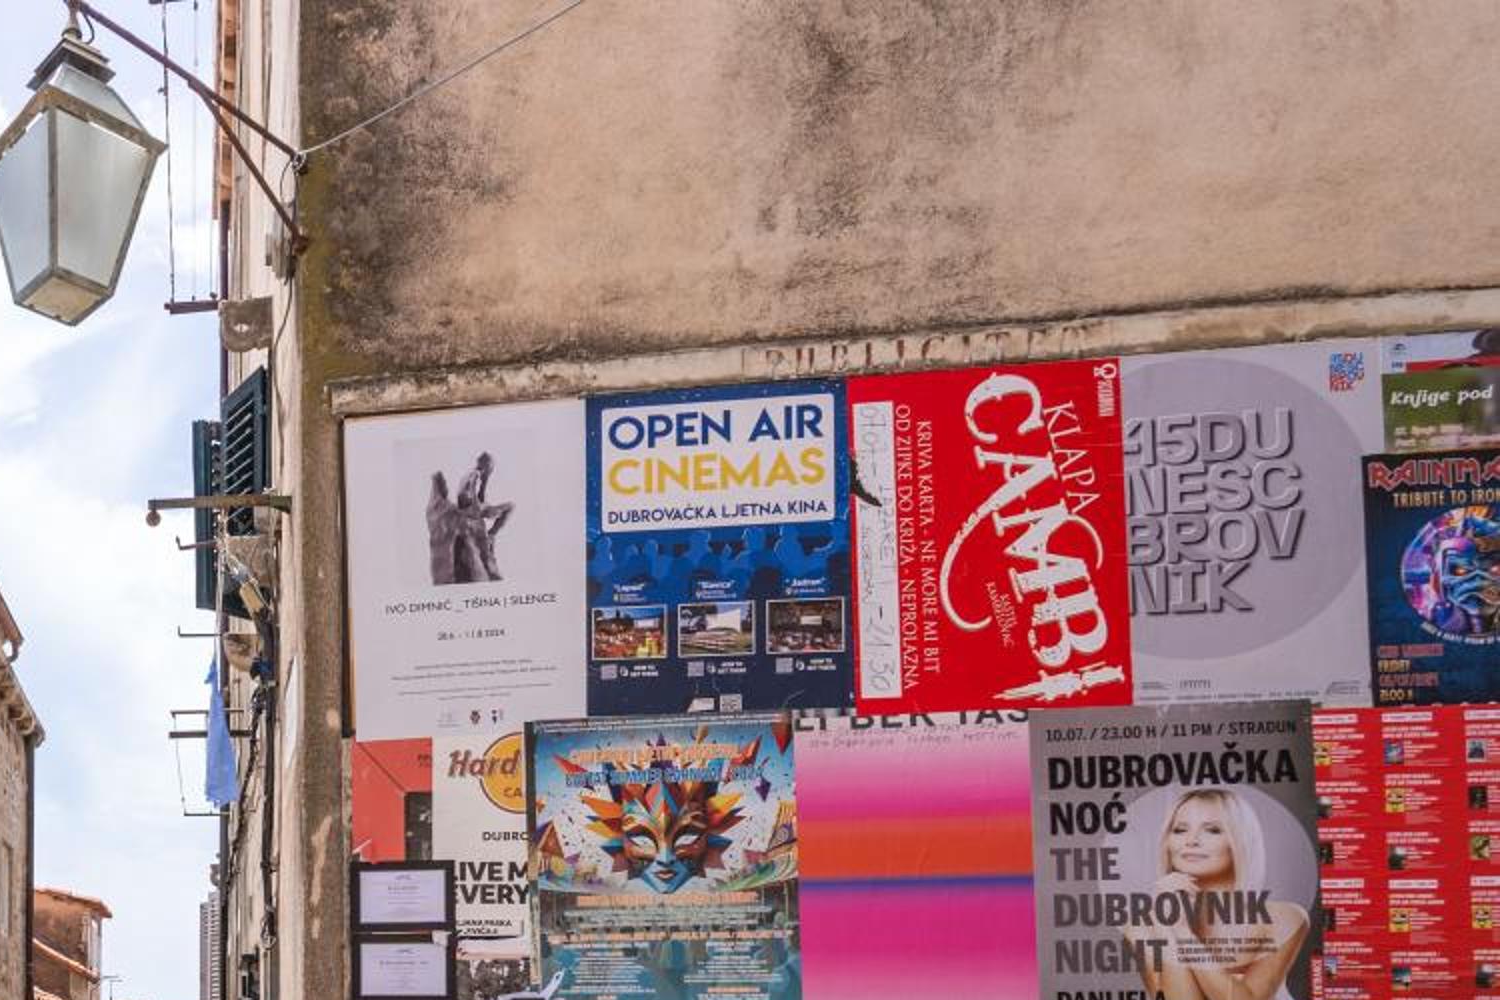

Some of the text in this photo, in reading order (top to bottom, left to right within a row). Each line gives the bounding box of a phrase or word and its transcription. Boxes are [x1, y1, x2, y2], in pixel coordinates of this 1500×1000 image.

[1390, 384, 1493, 408] Knjige pod
[608, 404, 824, 451] OPEN AIR
[895, 404, 911, 431] OD
[897, 435, 913, 480] ZIPKE
[917, 420, 932, 471] KRIVA
[1042, 400, 1102, 513] KLAPA
[609, 447, 826, 495] CINEMAS
[608, 499, 828, 525] DUBROVAČKA LJETNA KINA
[898, 485, 914, 512] DO
[918, 474, 934, 525] KARTA
[1393, 490, 1445, 508] TRIBUTE
[1450, 489, 1467, 504] TO
[899, 517, 917, 566] KRIŽA
[920, 539, 936, 562] NE
[1125, 509, 1306, 566] BROV
[386, 603, 405, 615] IVO
[921, 567, 938, 615] MORE
[1128, 562, 1256, 617] NIK
[901, 580, 920, 689] NEPROLAZNA
[923, 621, 938, 641] MI
[924, 646, 940, 673] BIT
[1045, 727, 1087, 742] 10.07.
[1101, 725, 1141, 740] 23.00
[1146, 724, 1157, 739] H
[1172, 723, 1187, 737] 11
[1191, 721, 1212, 736] PM
[1228, 719, 1297, 735] STRADUN
[449, 747, 521, 778] Hard
[1048, 742, 1298, 790] DUBROVAČKA
[1050, 792, 1127, 836] NOĆ
[1050, 847, 1120, 881] THE
[1053, 890, 1272, 929] DUBROVNIK
[1055, 938, 1168, 974] NIGHT
